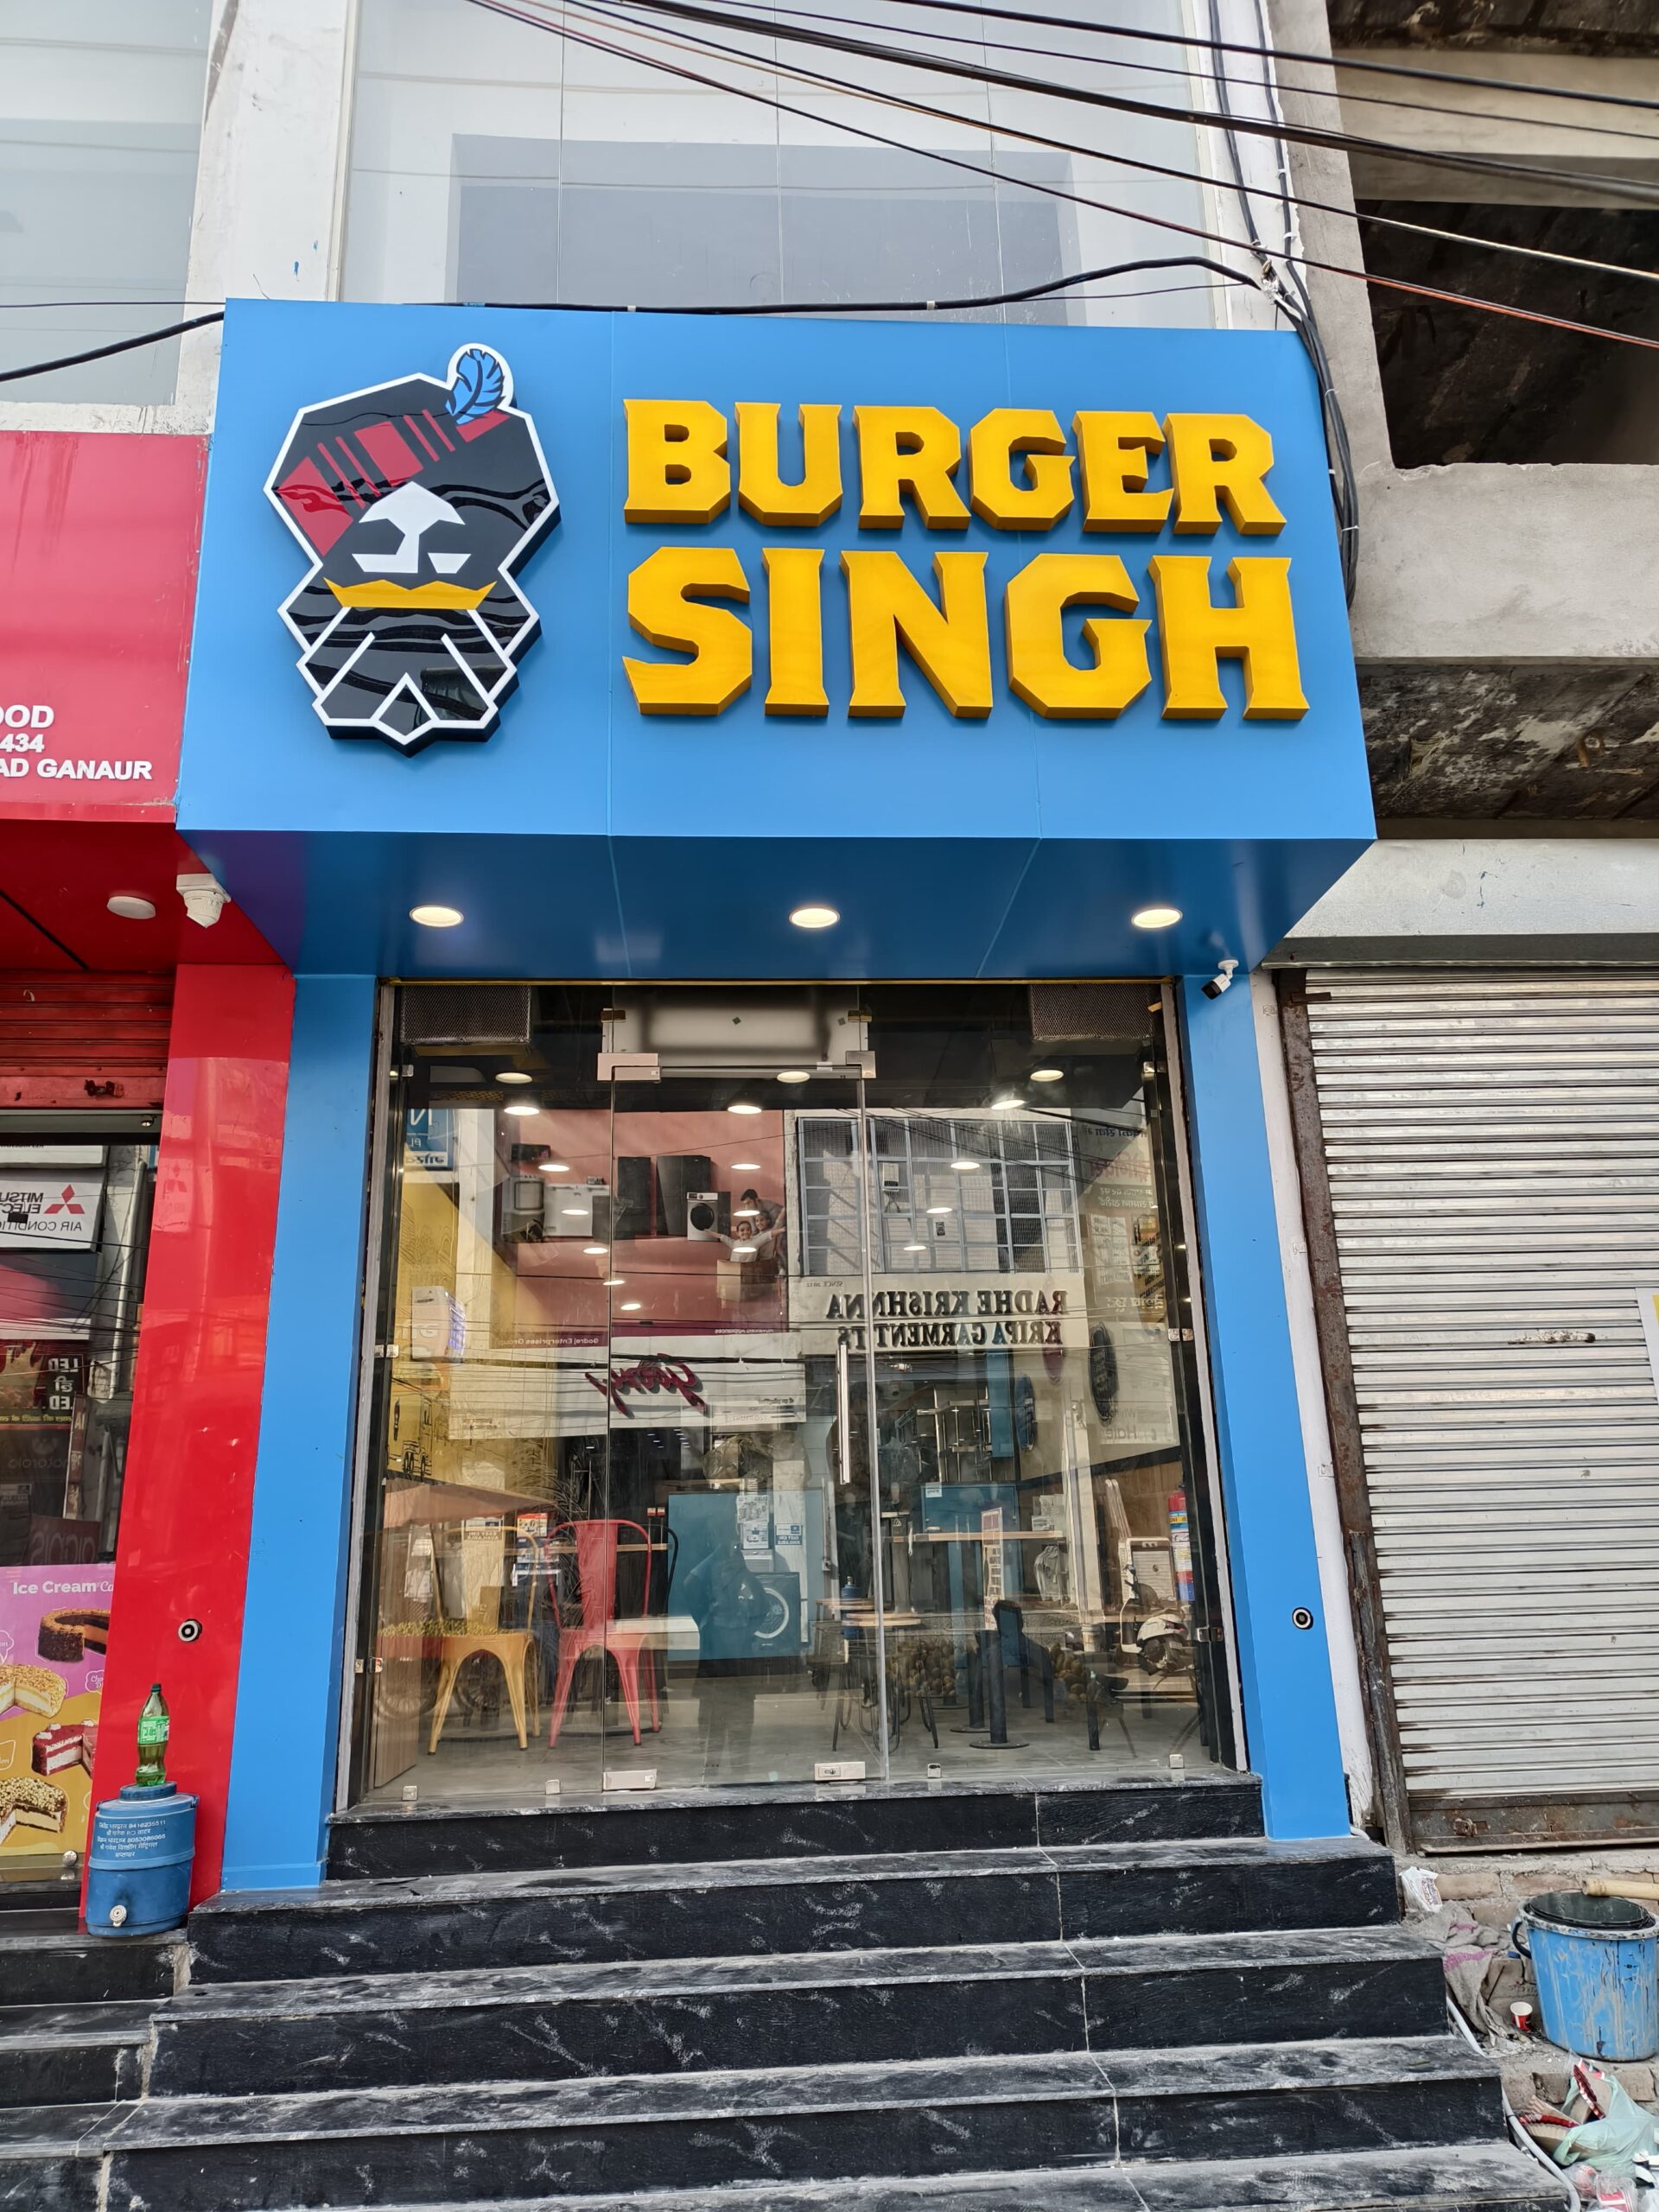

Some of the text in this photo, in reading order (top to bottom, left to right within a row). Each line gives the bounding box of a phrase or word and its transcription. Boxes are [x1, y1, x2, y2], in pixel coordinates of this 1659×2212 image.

[623, 399, 1287, 537] BURGER
[622, 546, 1311, 721] SINGH
[0, 704, 54, 728] OD
[36, 758, 152, 780] GANAUR
[13, 1581, 38, 1594] Ice
[41, 1580, 97, 1593] Cream
